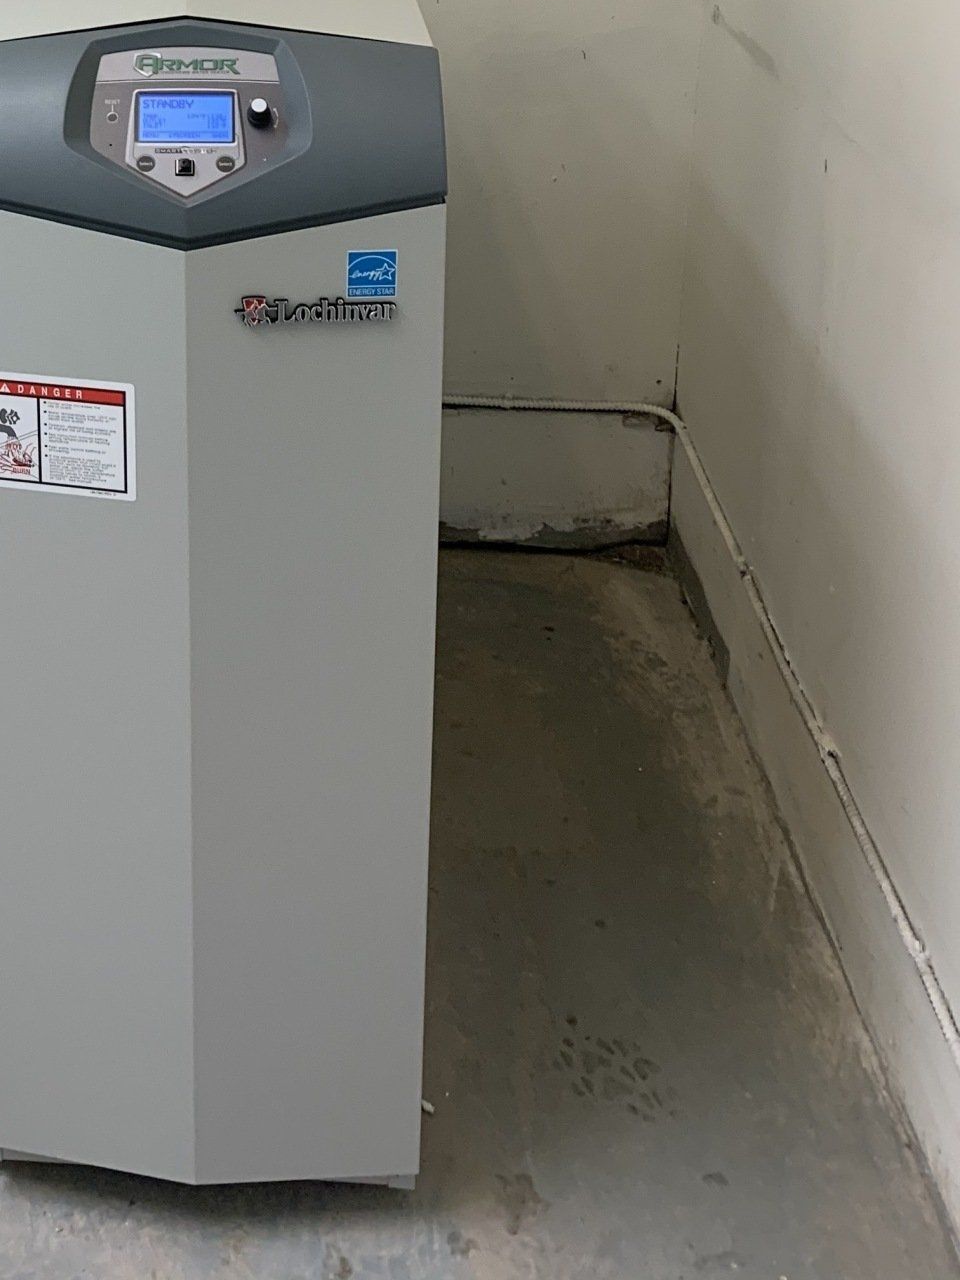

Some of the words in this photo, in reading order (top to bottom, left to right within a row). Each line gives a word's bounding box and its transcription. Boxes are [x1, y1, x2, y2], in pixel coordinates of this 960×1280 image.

[135, 54, 241, 75] ARMOR
[143, 99, 194, 109] STANDBY
[349, 287, 376, 296] ENERGY
[377, 287, 394, 295] STAR
[274, 298, 397, 323] Lochinvar
[17, 384, 83, 399] DANGER
